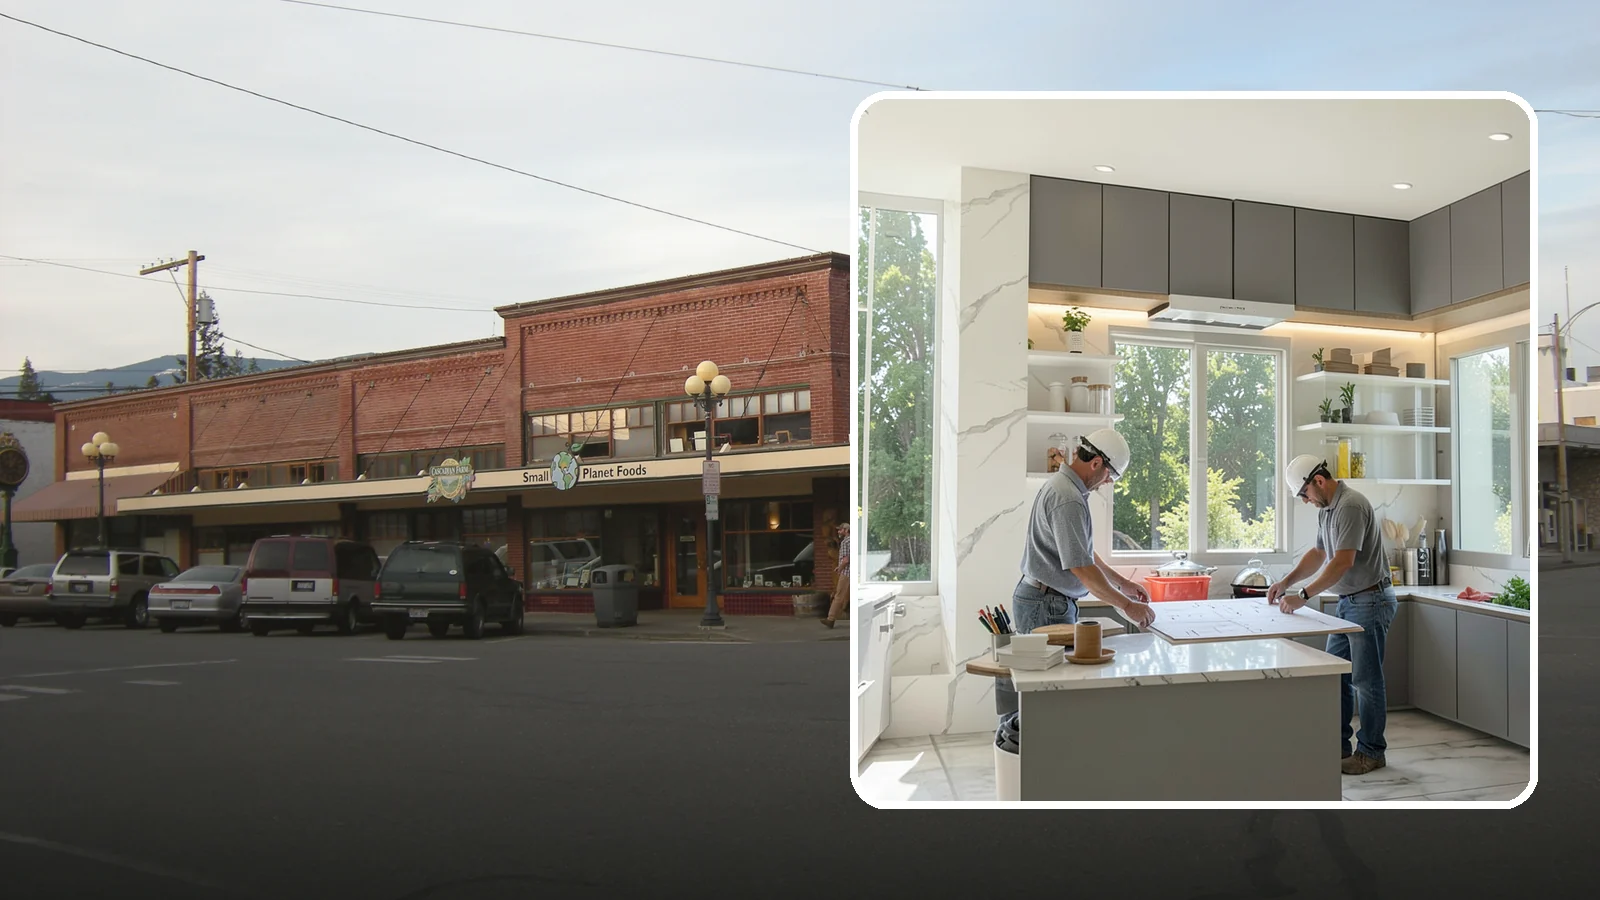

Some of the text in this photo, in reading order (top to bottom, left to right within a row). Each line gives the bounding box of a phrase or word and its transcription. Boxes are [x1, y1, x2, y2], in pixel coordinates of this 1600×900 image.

[523, 464, 647, 483] Small Planet Foods
